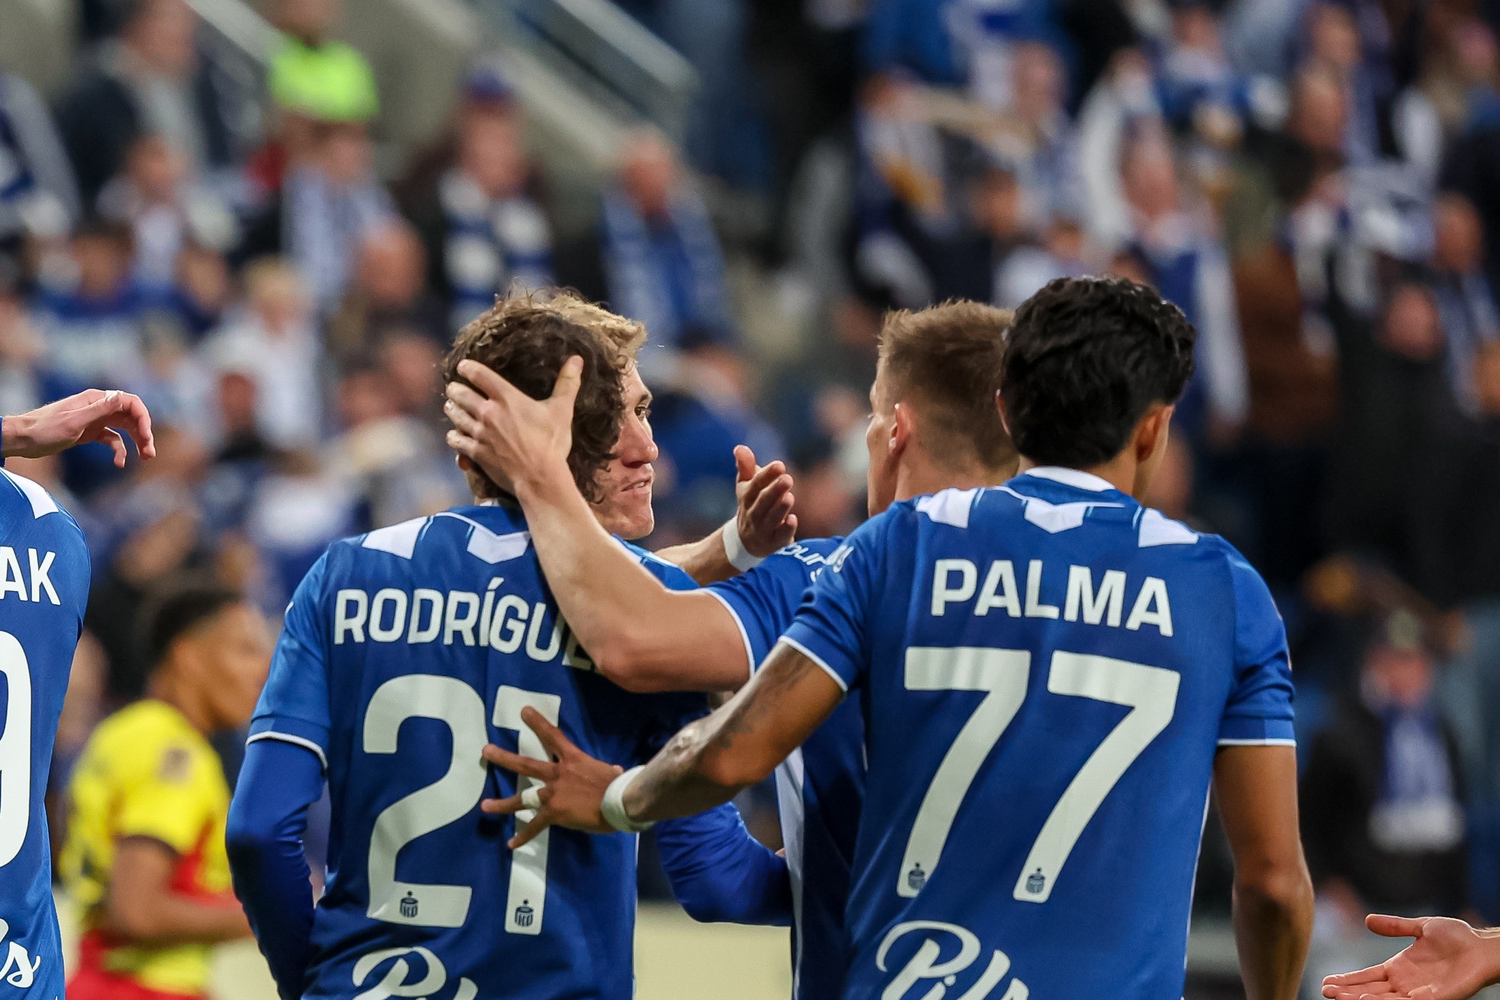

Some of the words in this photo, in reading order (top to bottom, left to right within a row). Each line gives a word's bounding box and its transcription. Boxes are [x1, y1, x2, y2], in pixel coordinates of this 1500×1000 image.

[334, 576, 600, 671] RODRÍGU
[930, 558, 1174, 637] PALMA
[362, 673, 561, 936] 21
[896, 646, 1182, 904] 77
